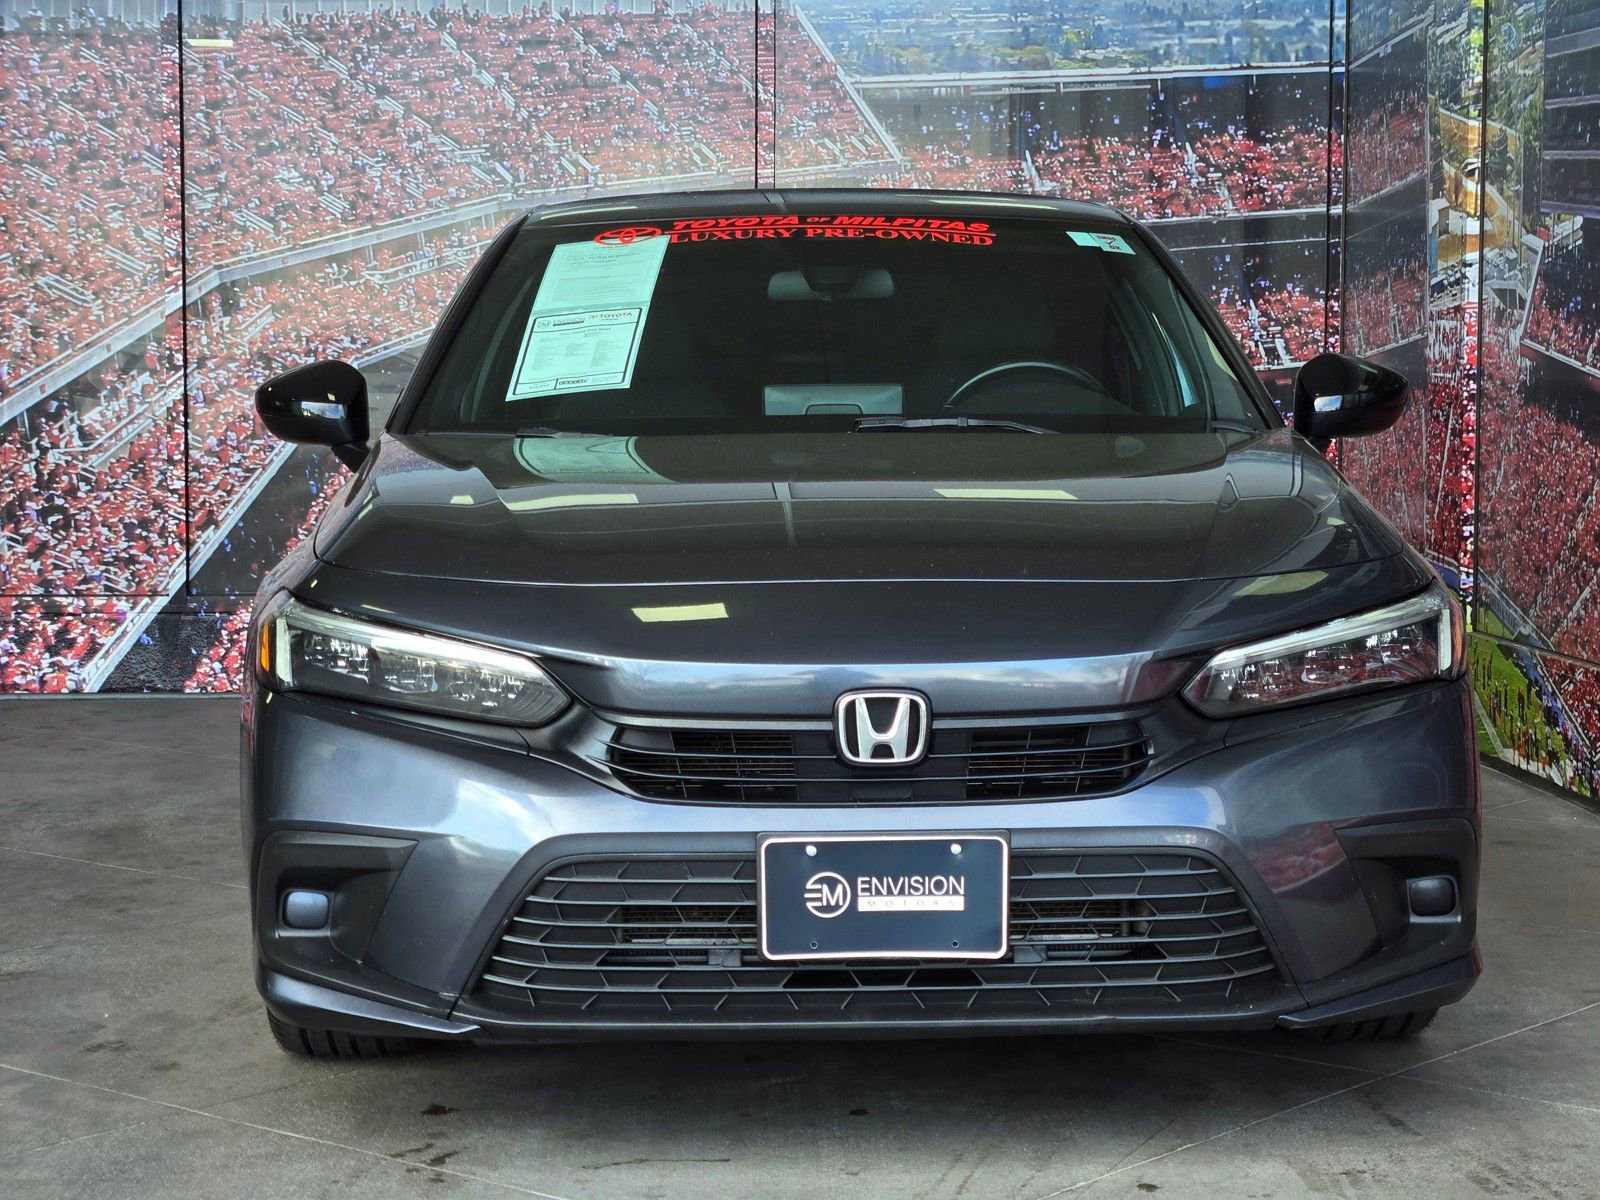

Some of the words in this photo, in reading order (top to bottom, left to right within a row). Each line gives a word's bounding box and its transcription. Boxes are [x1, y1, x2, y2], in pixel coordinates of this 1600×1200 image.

[673, 216, 799, 230] TOYOTA
[833, 216, 990, 232] MILPITAS
[670, 228, 798, 244] LUXURY
[805, 228, 993, 247] PRE-OWNED
[858, 875, 965, 897] ENVISION
